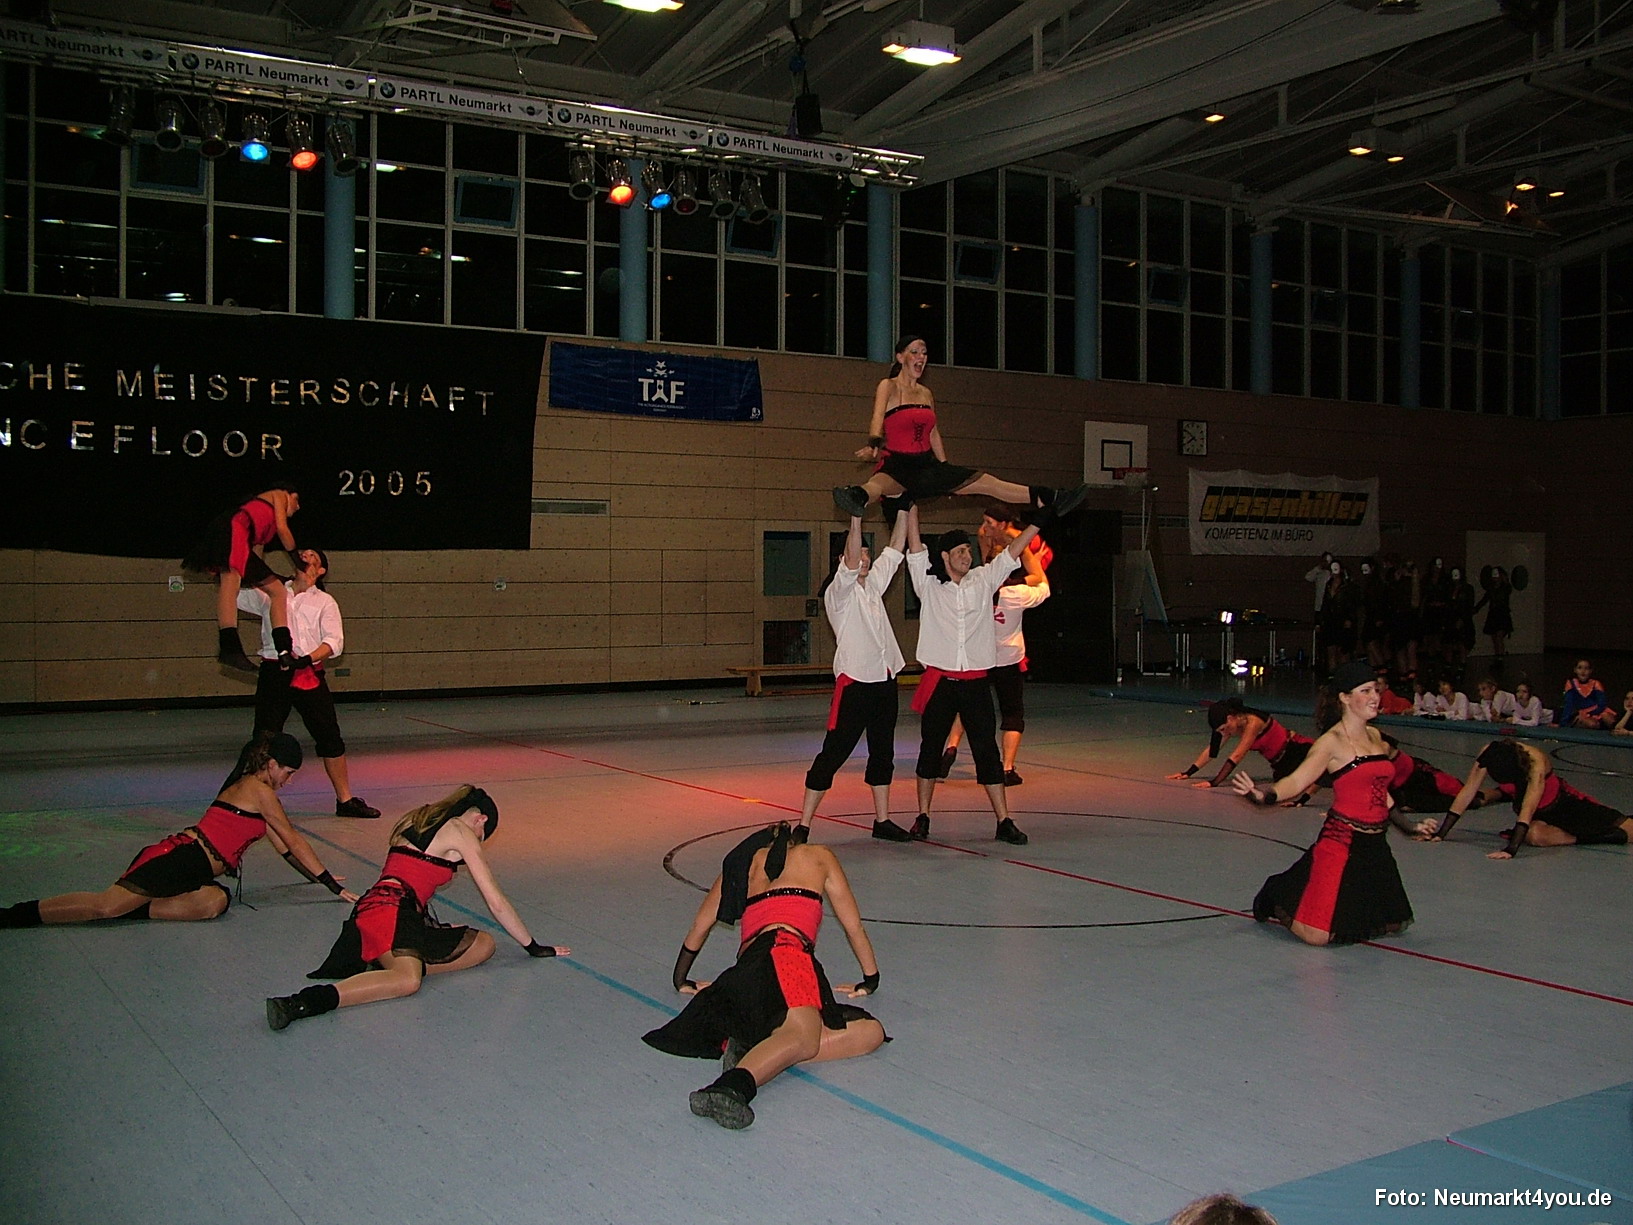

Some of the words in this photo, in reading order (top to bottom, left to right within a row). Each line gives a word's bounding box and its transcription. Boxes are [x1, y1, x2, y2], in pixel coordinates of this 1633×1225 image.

[45, 36, 125, 58] Neumarkt
[205, 58, 254, 76] PARTL
[259, 66, 329, 87] Neumarkt
[400, 86, 445, 104] PARTL
[449, 94, 512, 114] Neumarkt
[576, 112, 616, 128] PARTL
[620, 119, 677, 137] Neumarkt
[733, 136, 769, 151] PARTL
[773, 143, 824, 160] Neumarkt
[116, 369, 494, 415] MEISTERSCHAFT
[339, 470, 431, 496] 2005
[1285, 528, 1314, 542] BÜRO
